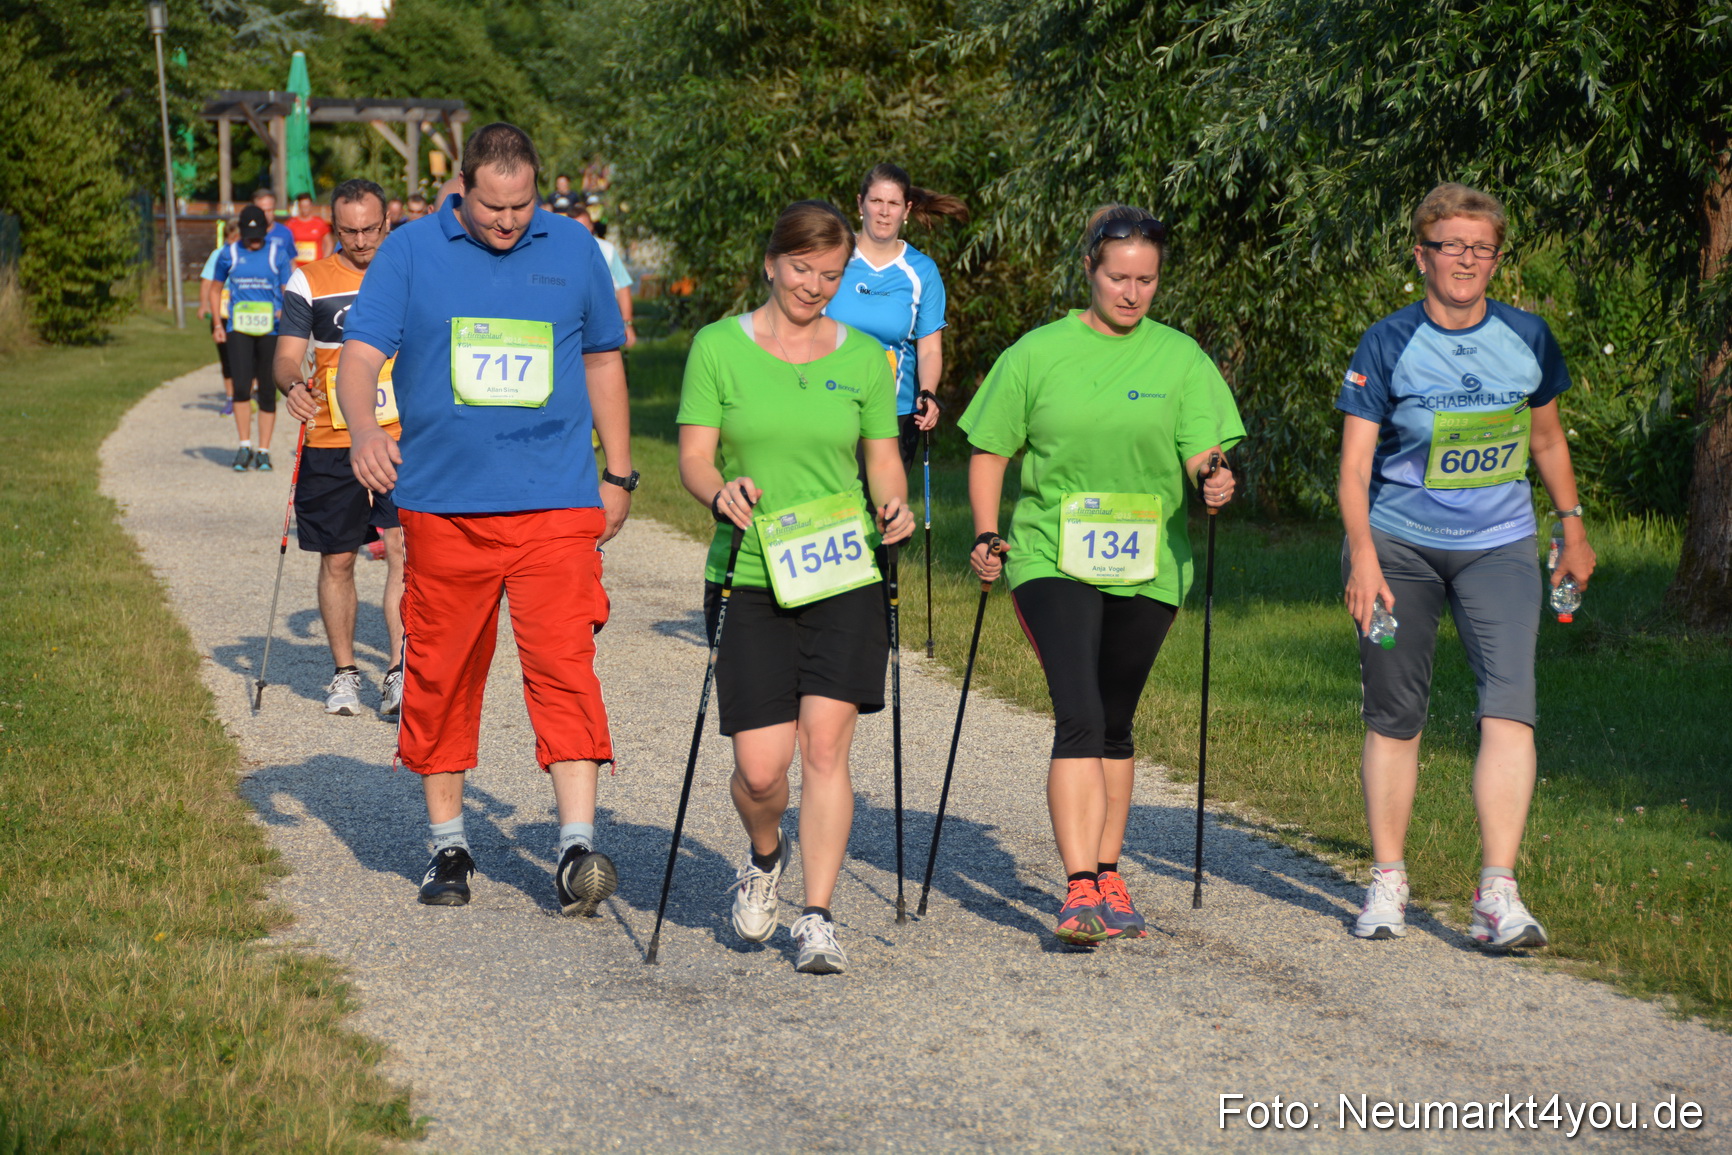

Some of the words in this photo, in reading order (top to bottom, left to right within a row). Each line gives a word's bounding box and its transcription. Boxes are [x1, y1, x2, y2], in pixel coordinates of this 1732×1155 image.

[531, 273, 566, 287] Fitness
[238, 314, 268, 327] 1358
[472, 353, 533, 381] 717
[1418, 391, 1526, 410] SCHABMÜLLER
[1440, 442, 1519, 474] 6087
[779, 530, 862, 579] 1545
[1082, 530, 1140, 560] 134
